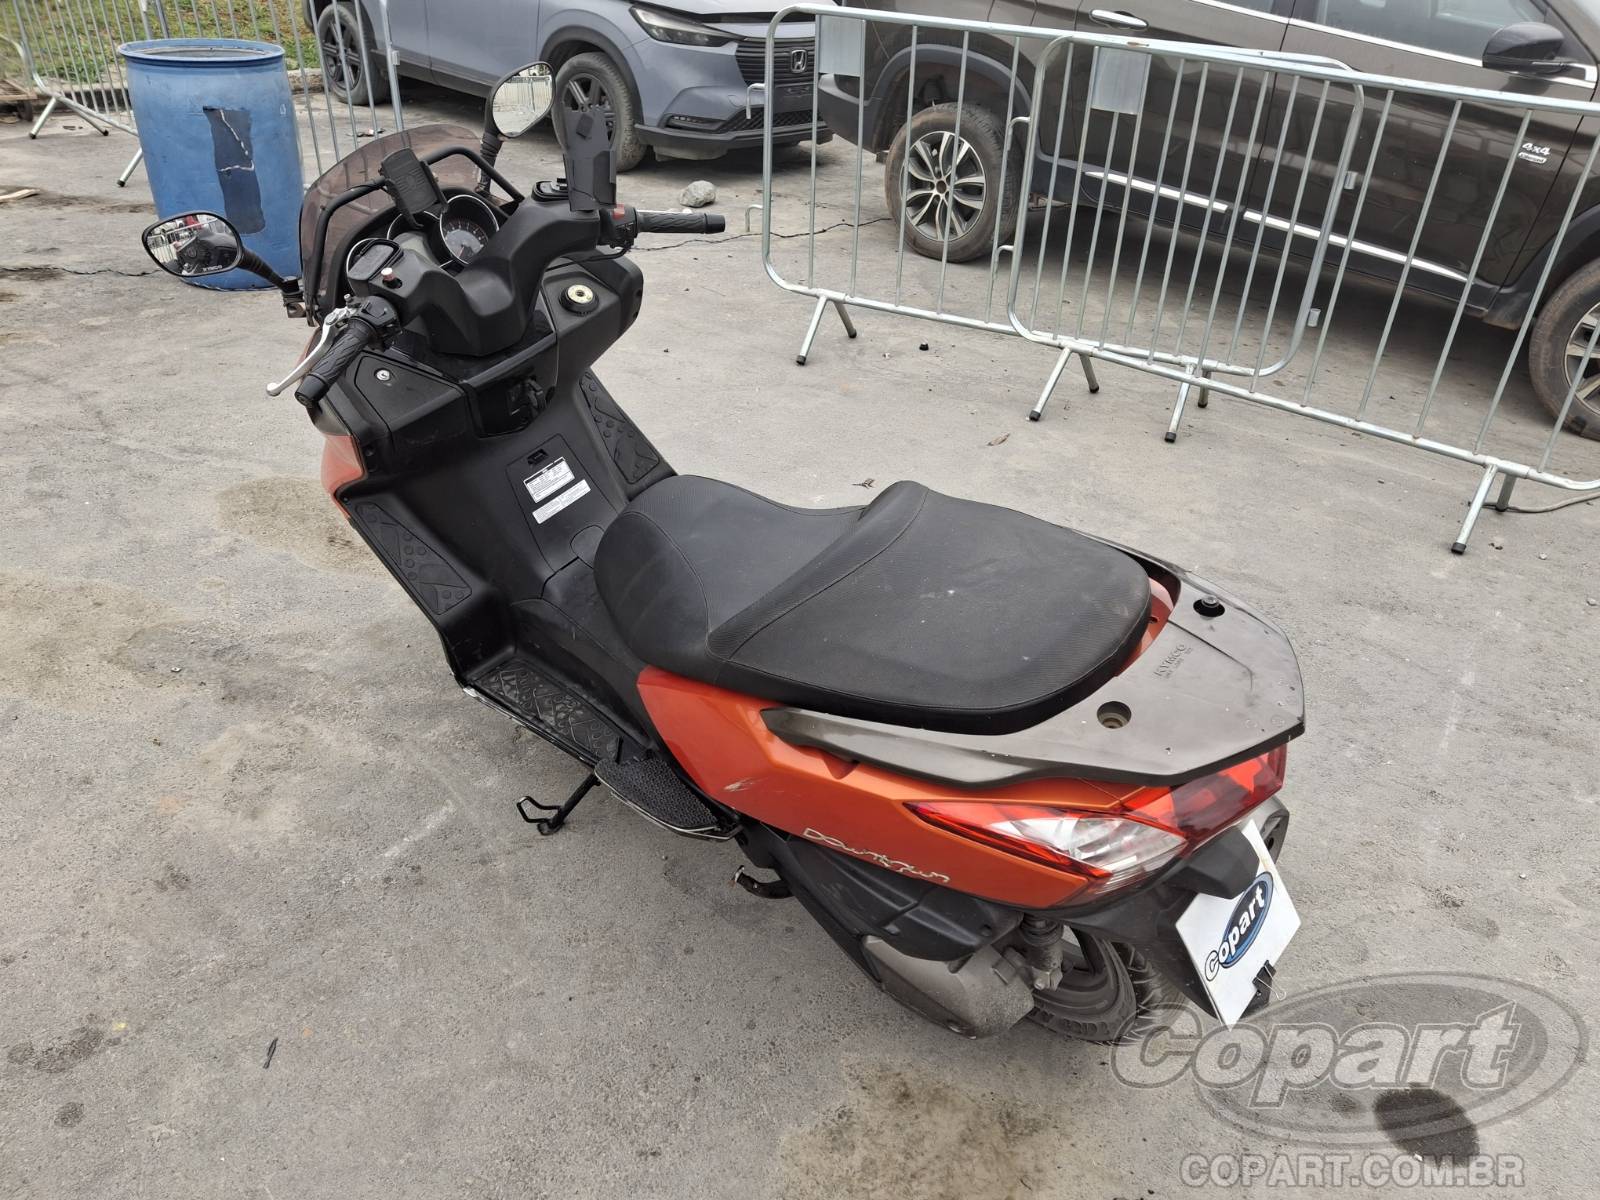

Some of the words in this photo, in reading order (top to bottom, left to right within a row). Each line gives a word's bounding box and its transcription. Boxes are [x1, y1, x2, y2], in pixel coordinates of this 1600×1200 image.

[1522, 142, 1551, 156] 4x4
[802, 827, 951, 884] Downtown
[1204, 884, 1266, 982] Copart
